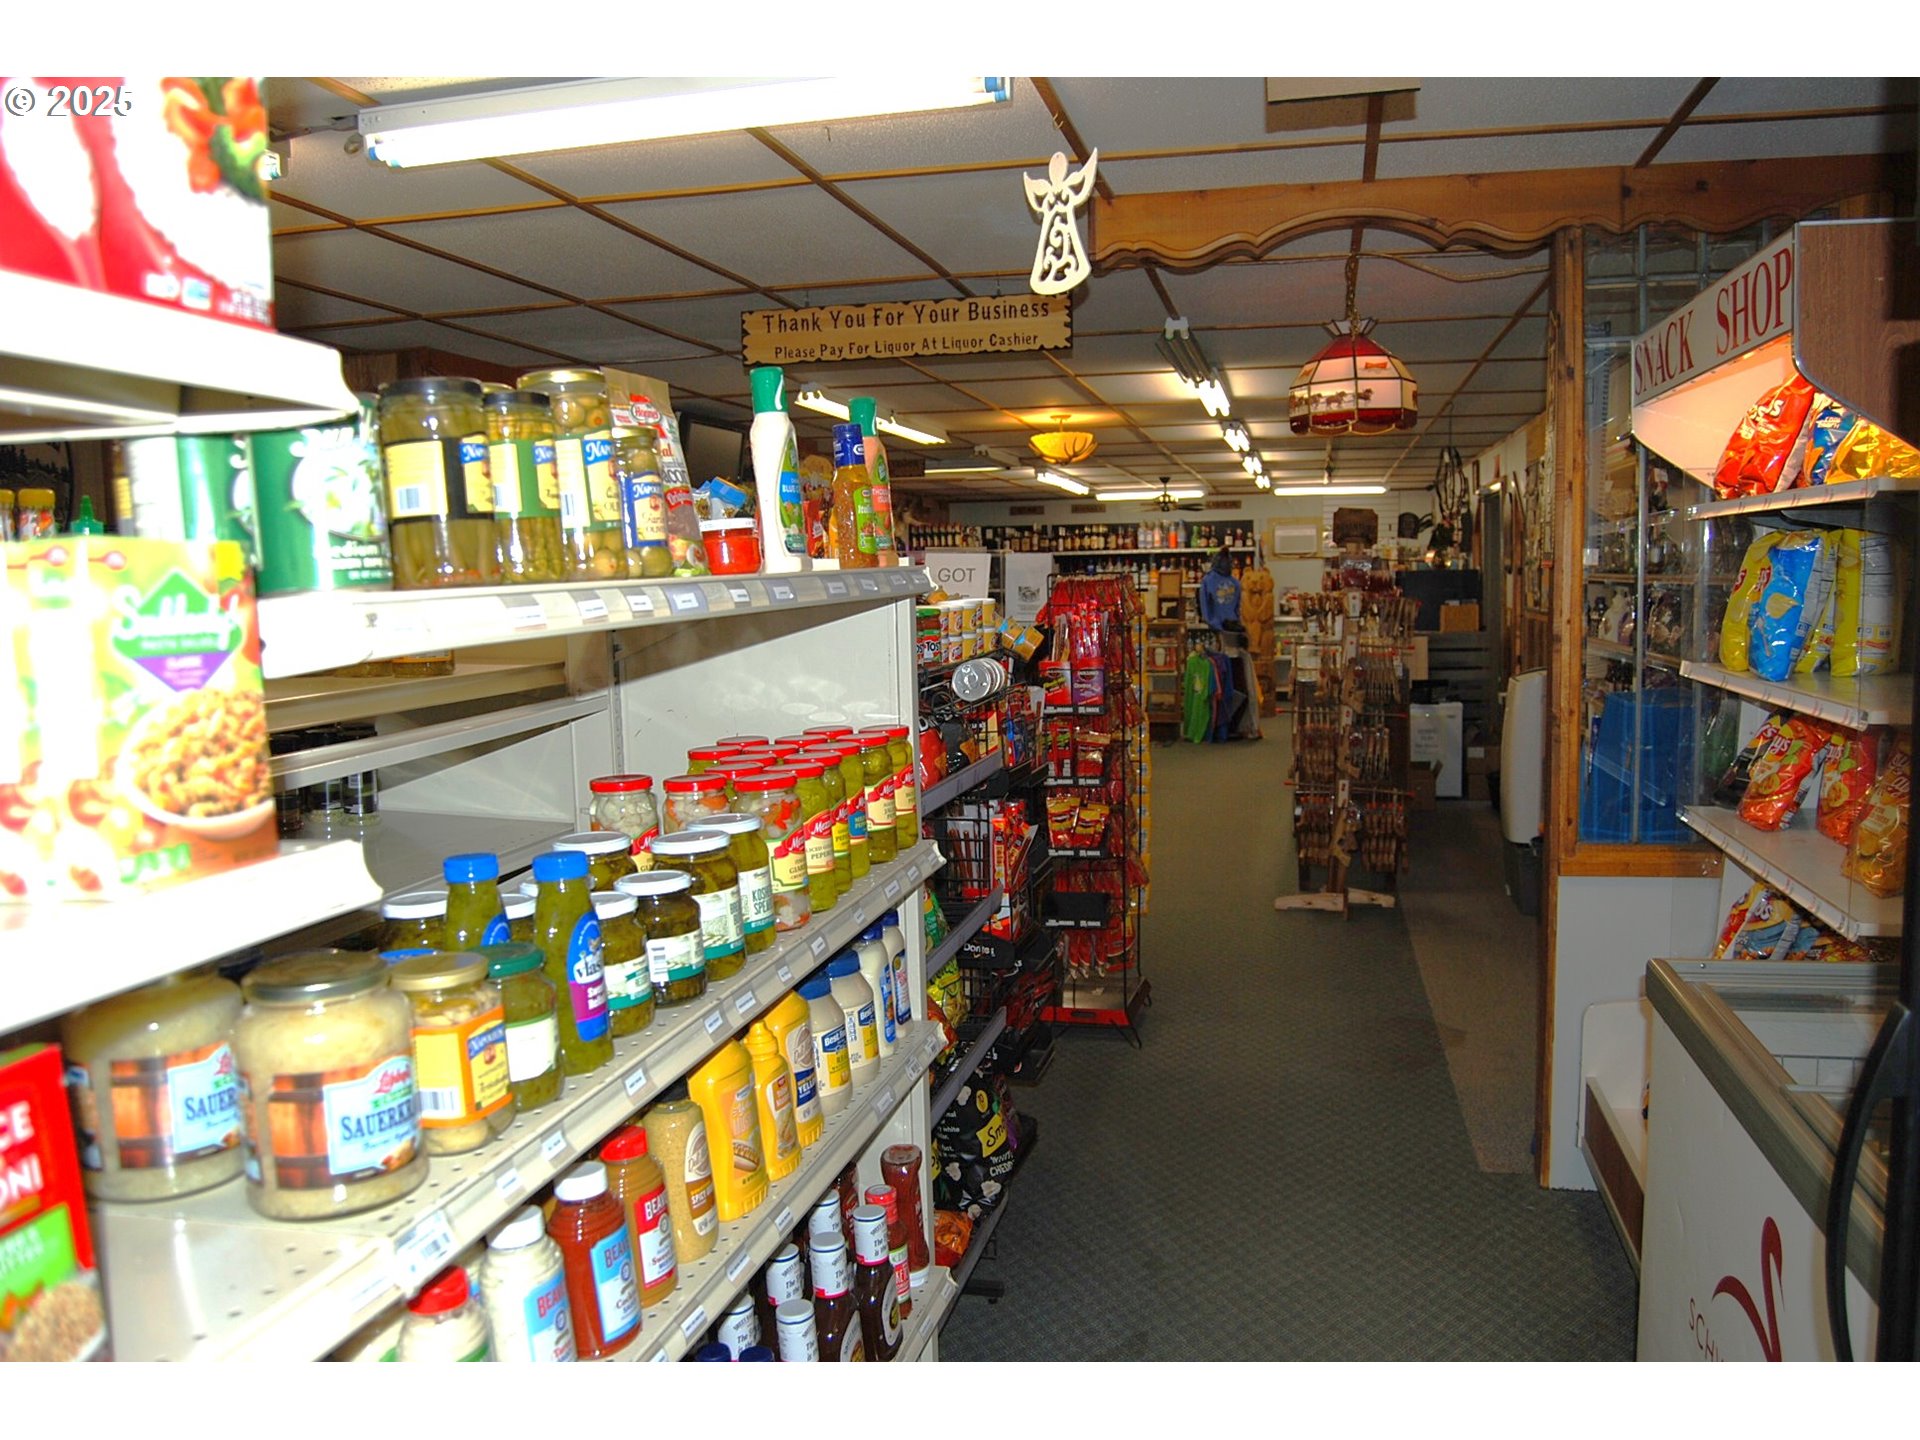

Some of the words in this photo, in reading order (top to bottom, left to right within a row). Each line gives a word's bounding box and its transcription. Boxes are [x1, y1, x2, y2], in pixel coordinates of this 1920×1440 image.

[763, 313, 822, 333] Thank
[830, 310, 865, 329] You
[873, 307, 905, 327] For
[913, 304, 960, 324] Your
[968, 301, 1050, 321] Business
[1634, 309, 1695, 395] SNACK
[1716, 248, 1791, 356] SHOP
[775, 346, 815, 359] Please
[820, 343, 843, 360] Pay
[849, 342, 870, 355] For
[875, 339, 916, 355] Liquor
[922, 337, 937, 350] At
[942, 336, 983, 351] Liquor
[989, 333, 1038, 347] Cashier
[938, 567, 977, 582] GOT
